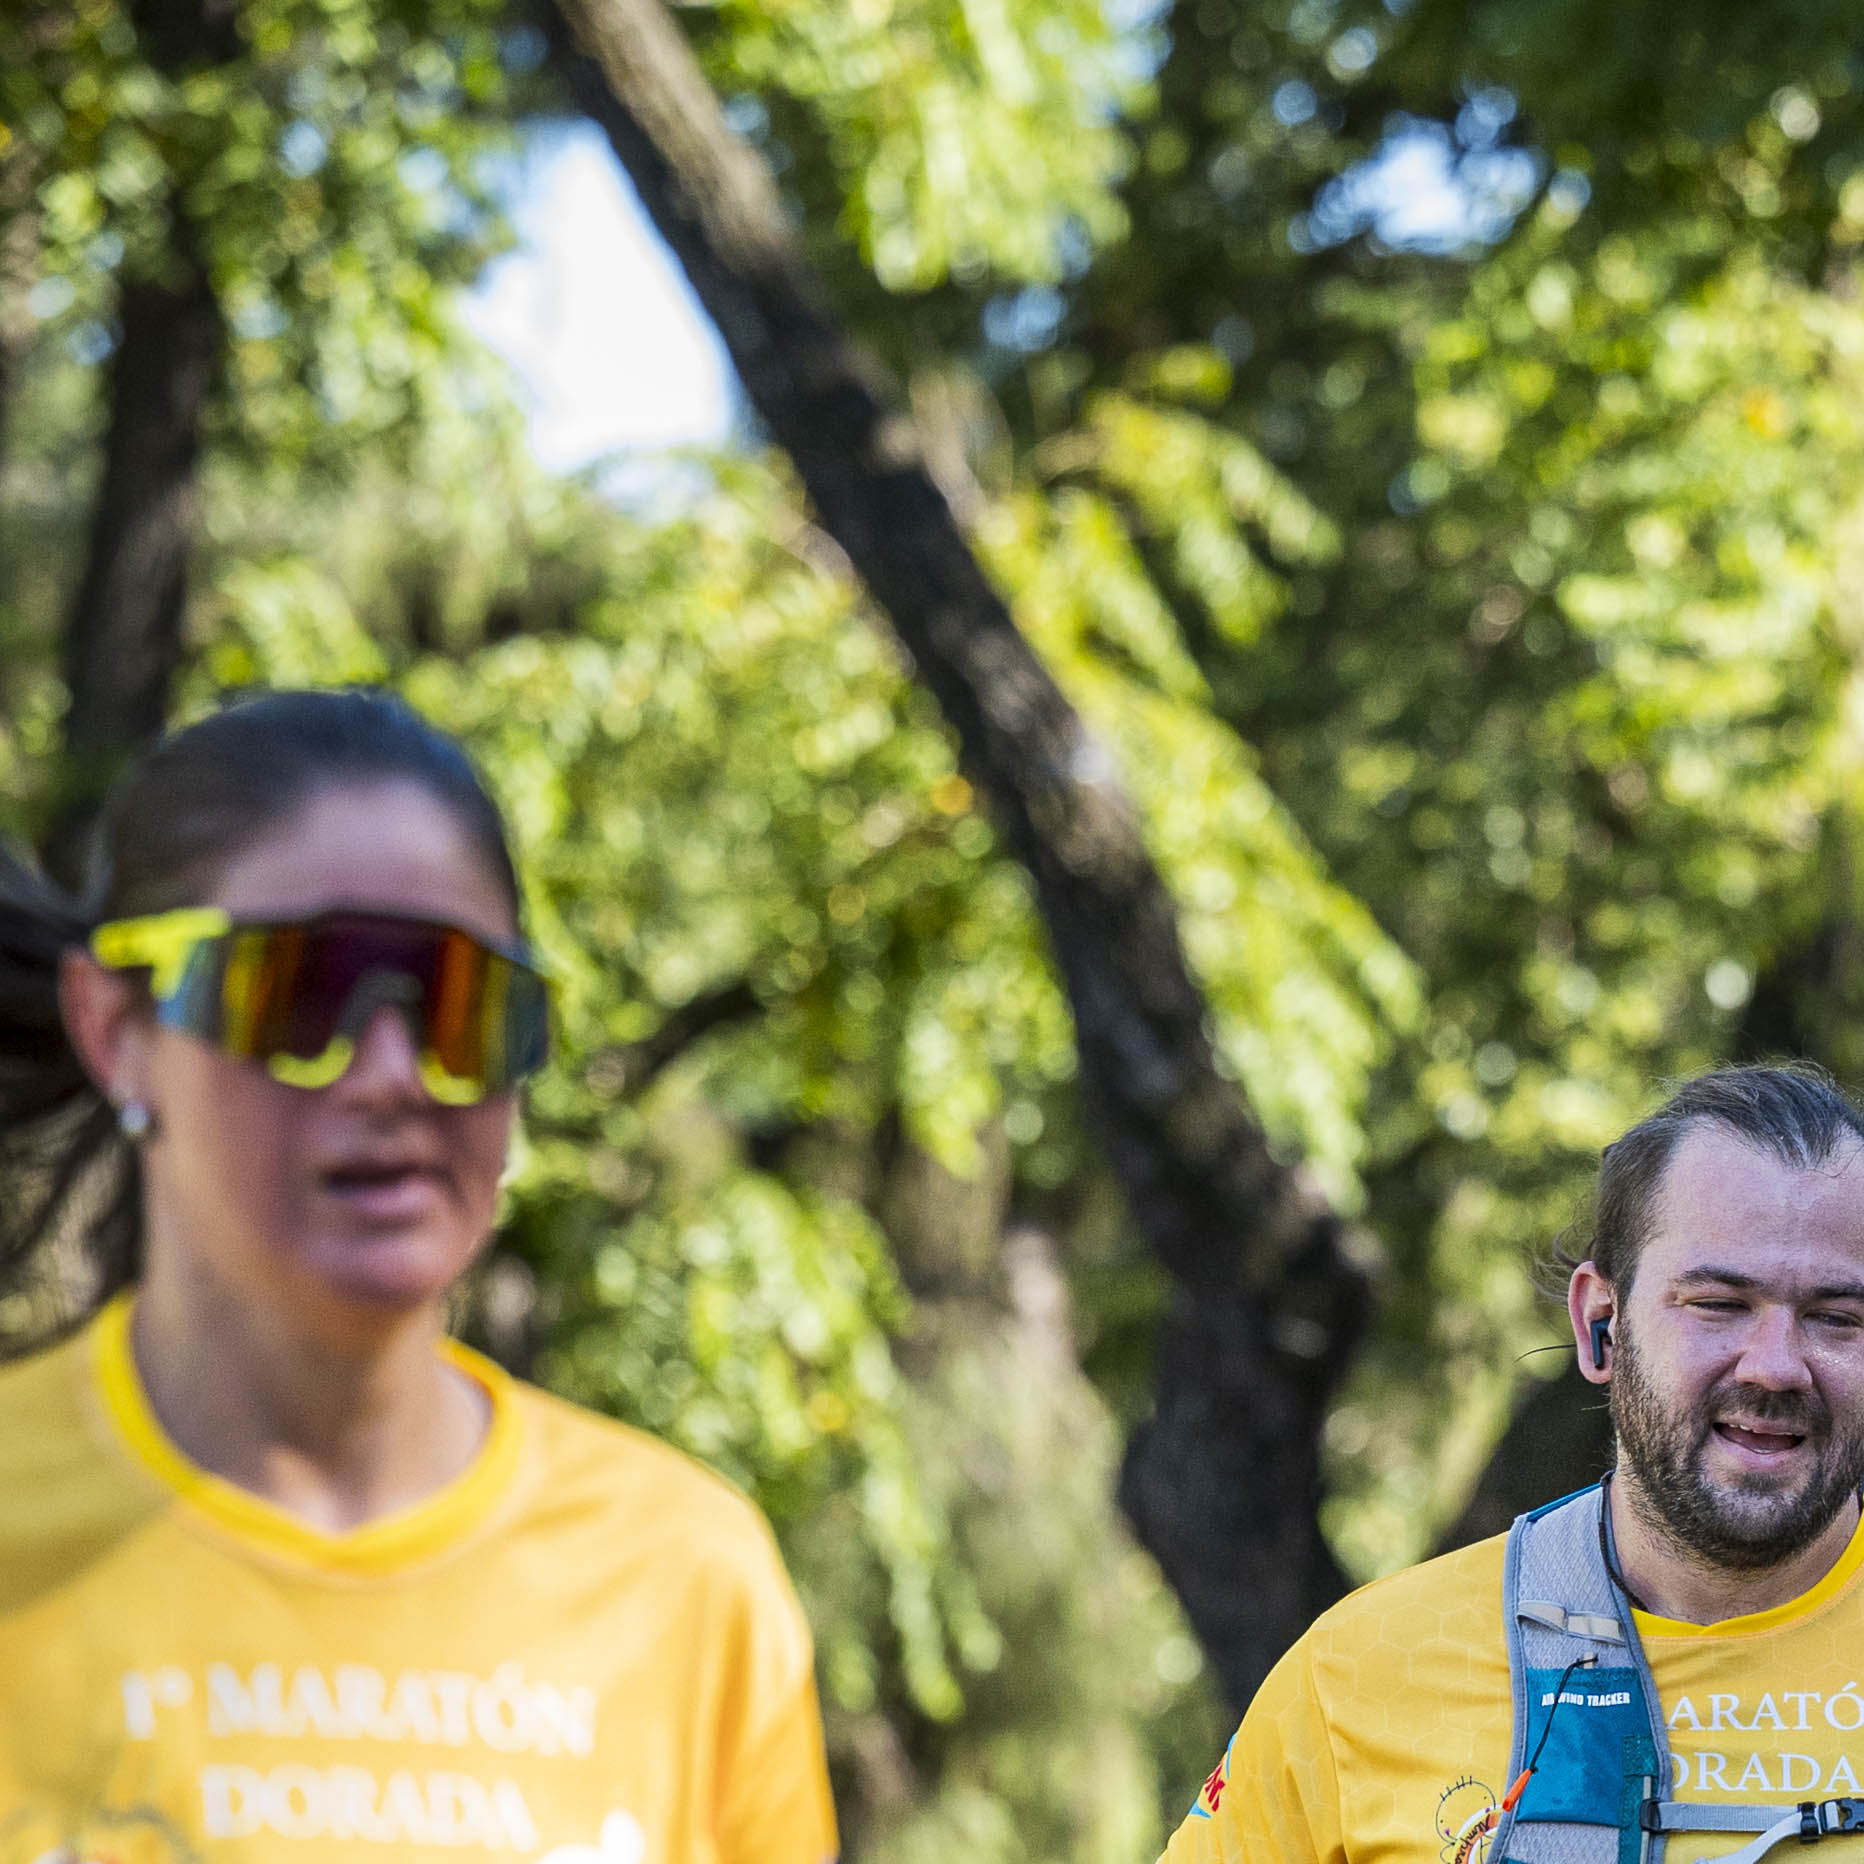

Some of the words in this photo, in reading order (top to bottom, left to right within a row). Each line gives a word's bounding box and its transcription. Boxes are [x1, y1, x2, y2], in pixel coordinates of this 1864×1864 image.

[206, 1661, 597, 1758] MARATÓN
[1587, 1691, 1630, 1707] TRACKER
[200, 1763, 539, 1853] DORADA
